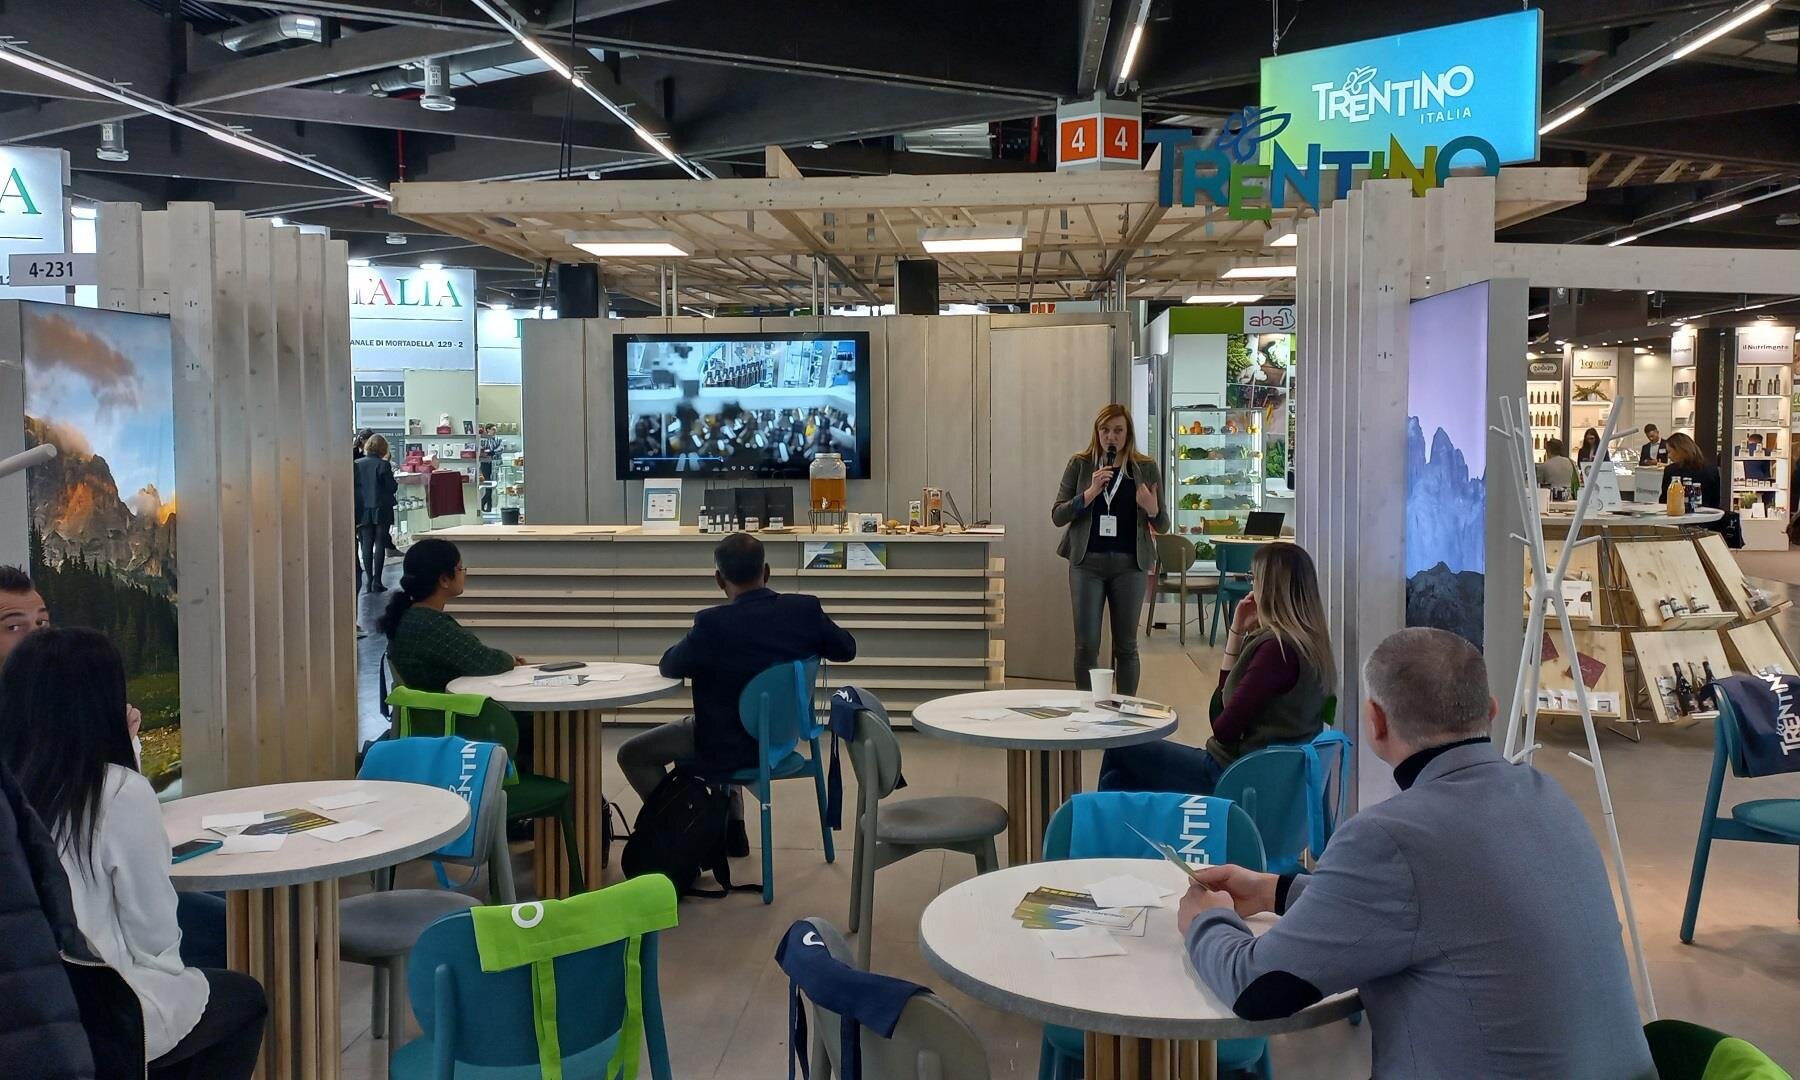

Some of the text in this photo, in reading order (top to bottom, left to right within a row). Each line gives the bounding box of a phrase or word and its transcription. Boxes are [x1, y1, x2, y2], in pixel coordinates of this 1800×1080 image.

[1311, 65, 1475, 123] TRENTINO
[1420, 106, 1472, 125] ITALIA
[1071, 126, 1086, 153] 4
[1114, 126, 1128, 152] 4
[29, 261, 74, 278] 4-231
[376, 339, 384, 347] DI
[385, 340, 434, 348] MORTADELLA
